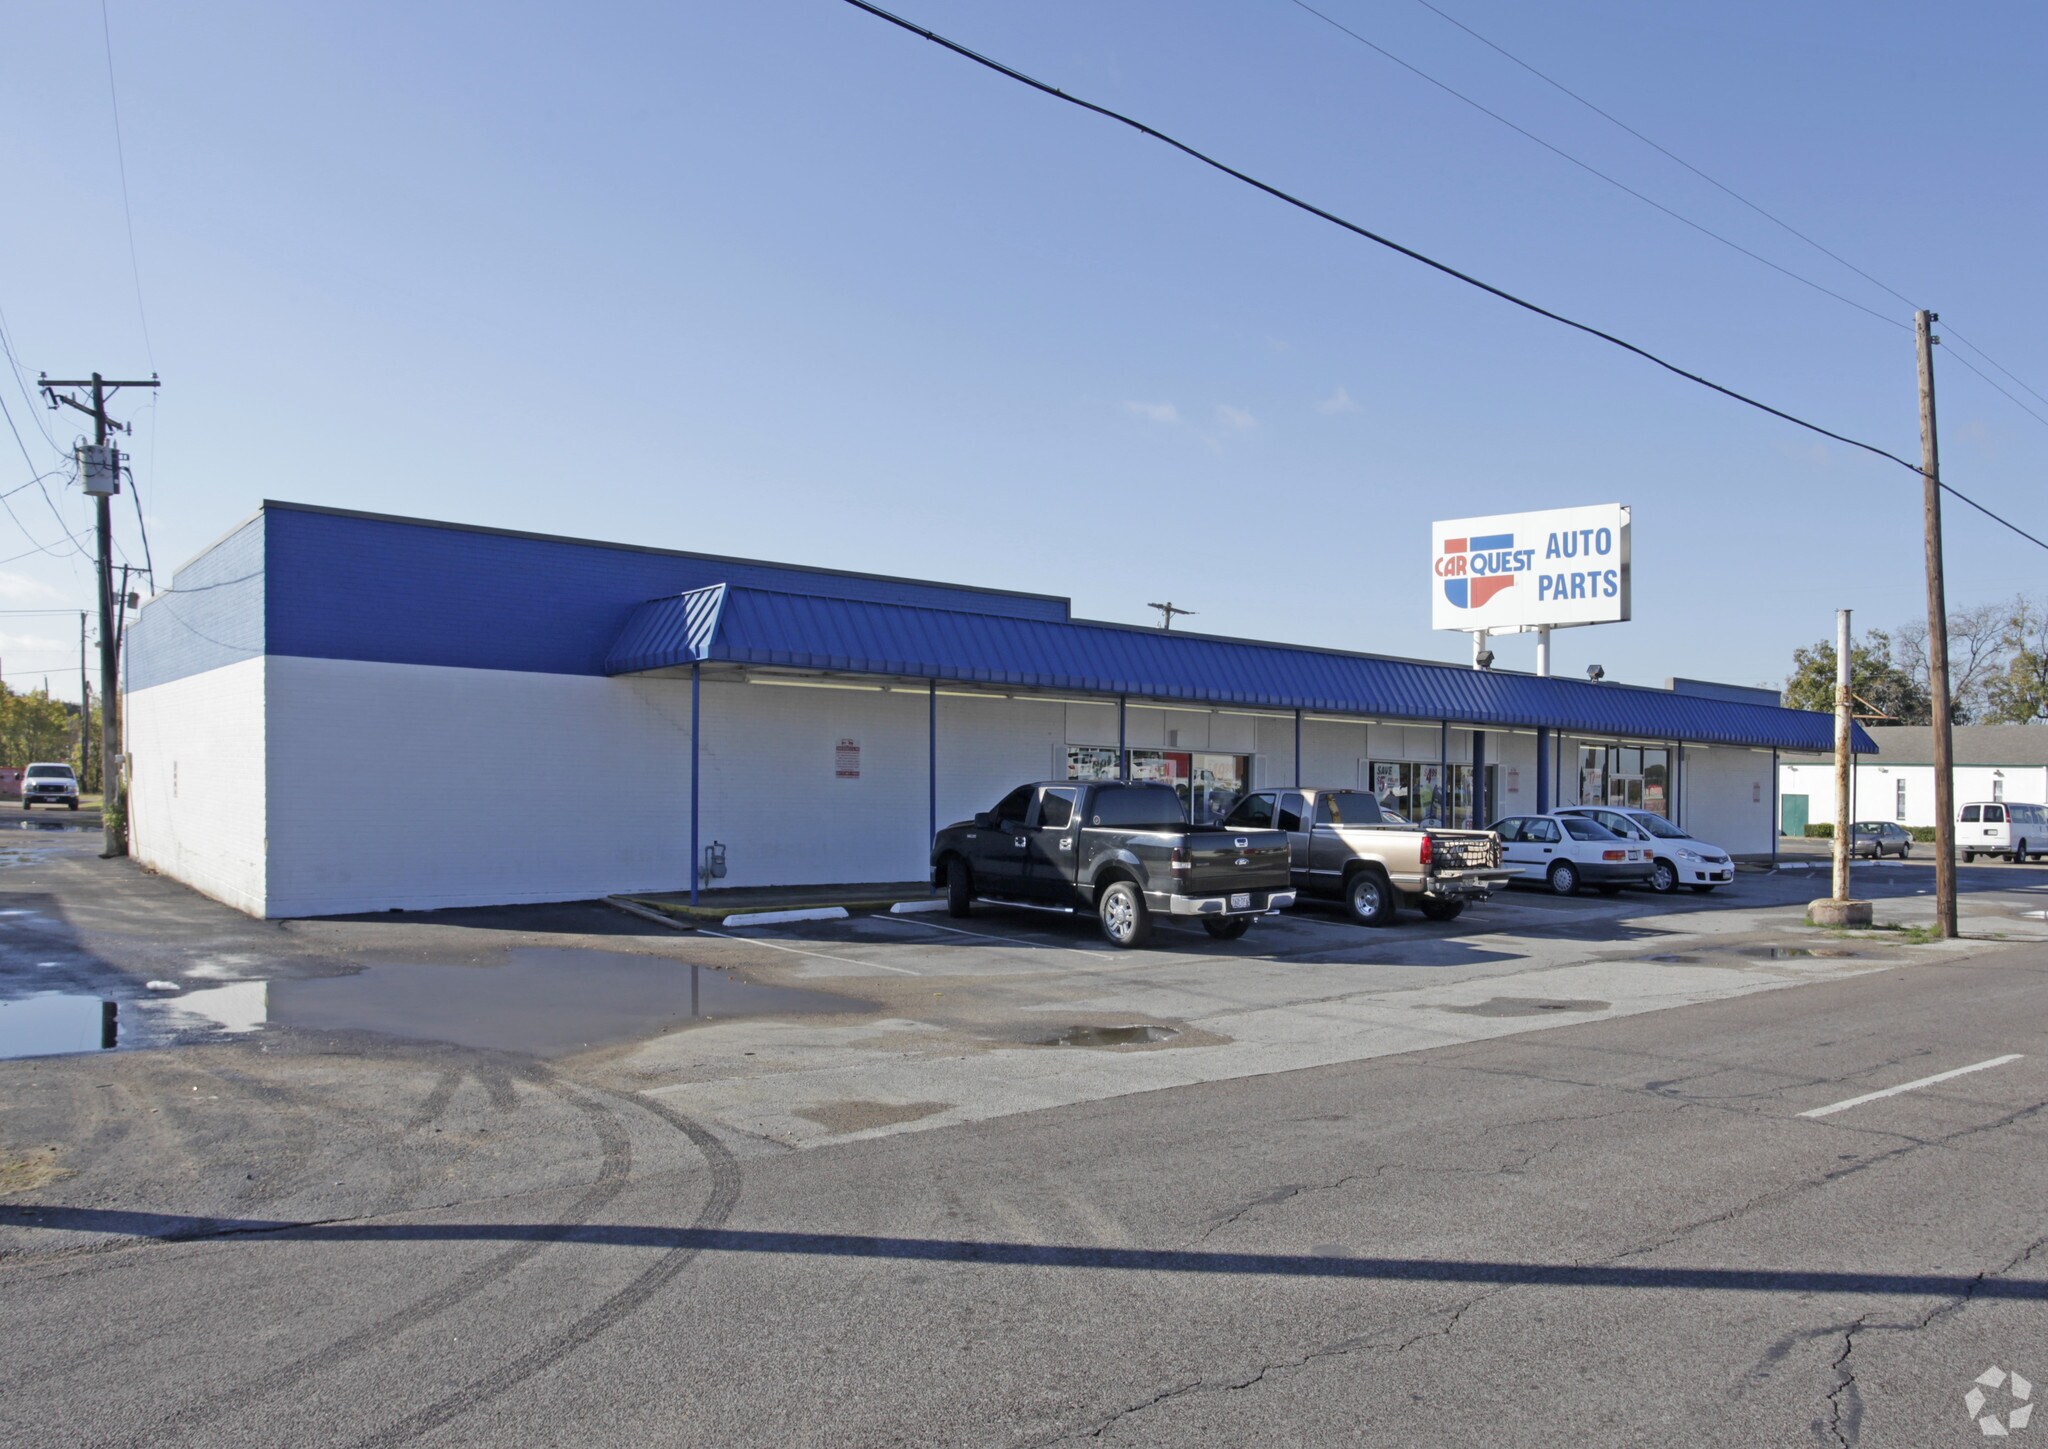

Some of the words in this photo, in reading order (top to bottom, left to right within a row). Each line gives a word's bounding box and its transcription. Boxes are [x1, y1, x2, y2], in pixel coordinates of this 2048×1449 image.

[1545, 527, 1612, 560] AUTO
[1538, 569, 1618, 602] PARTS
[1377, 765, 1392, 776] SAVE
